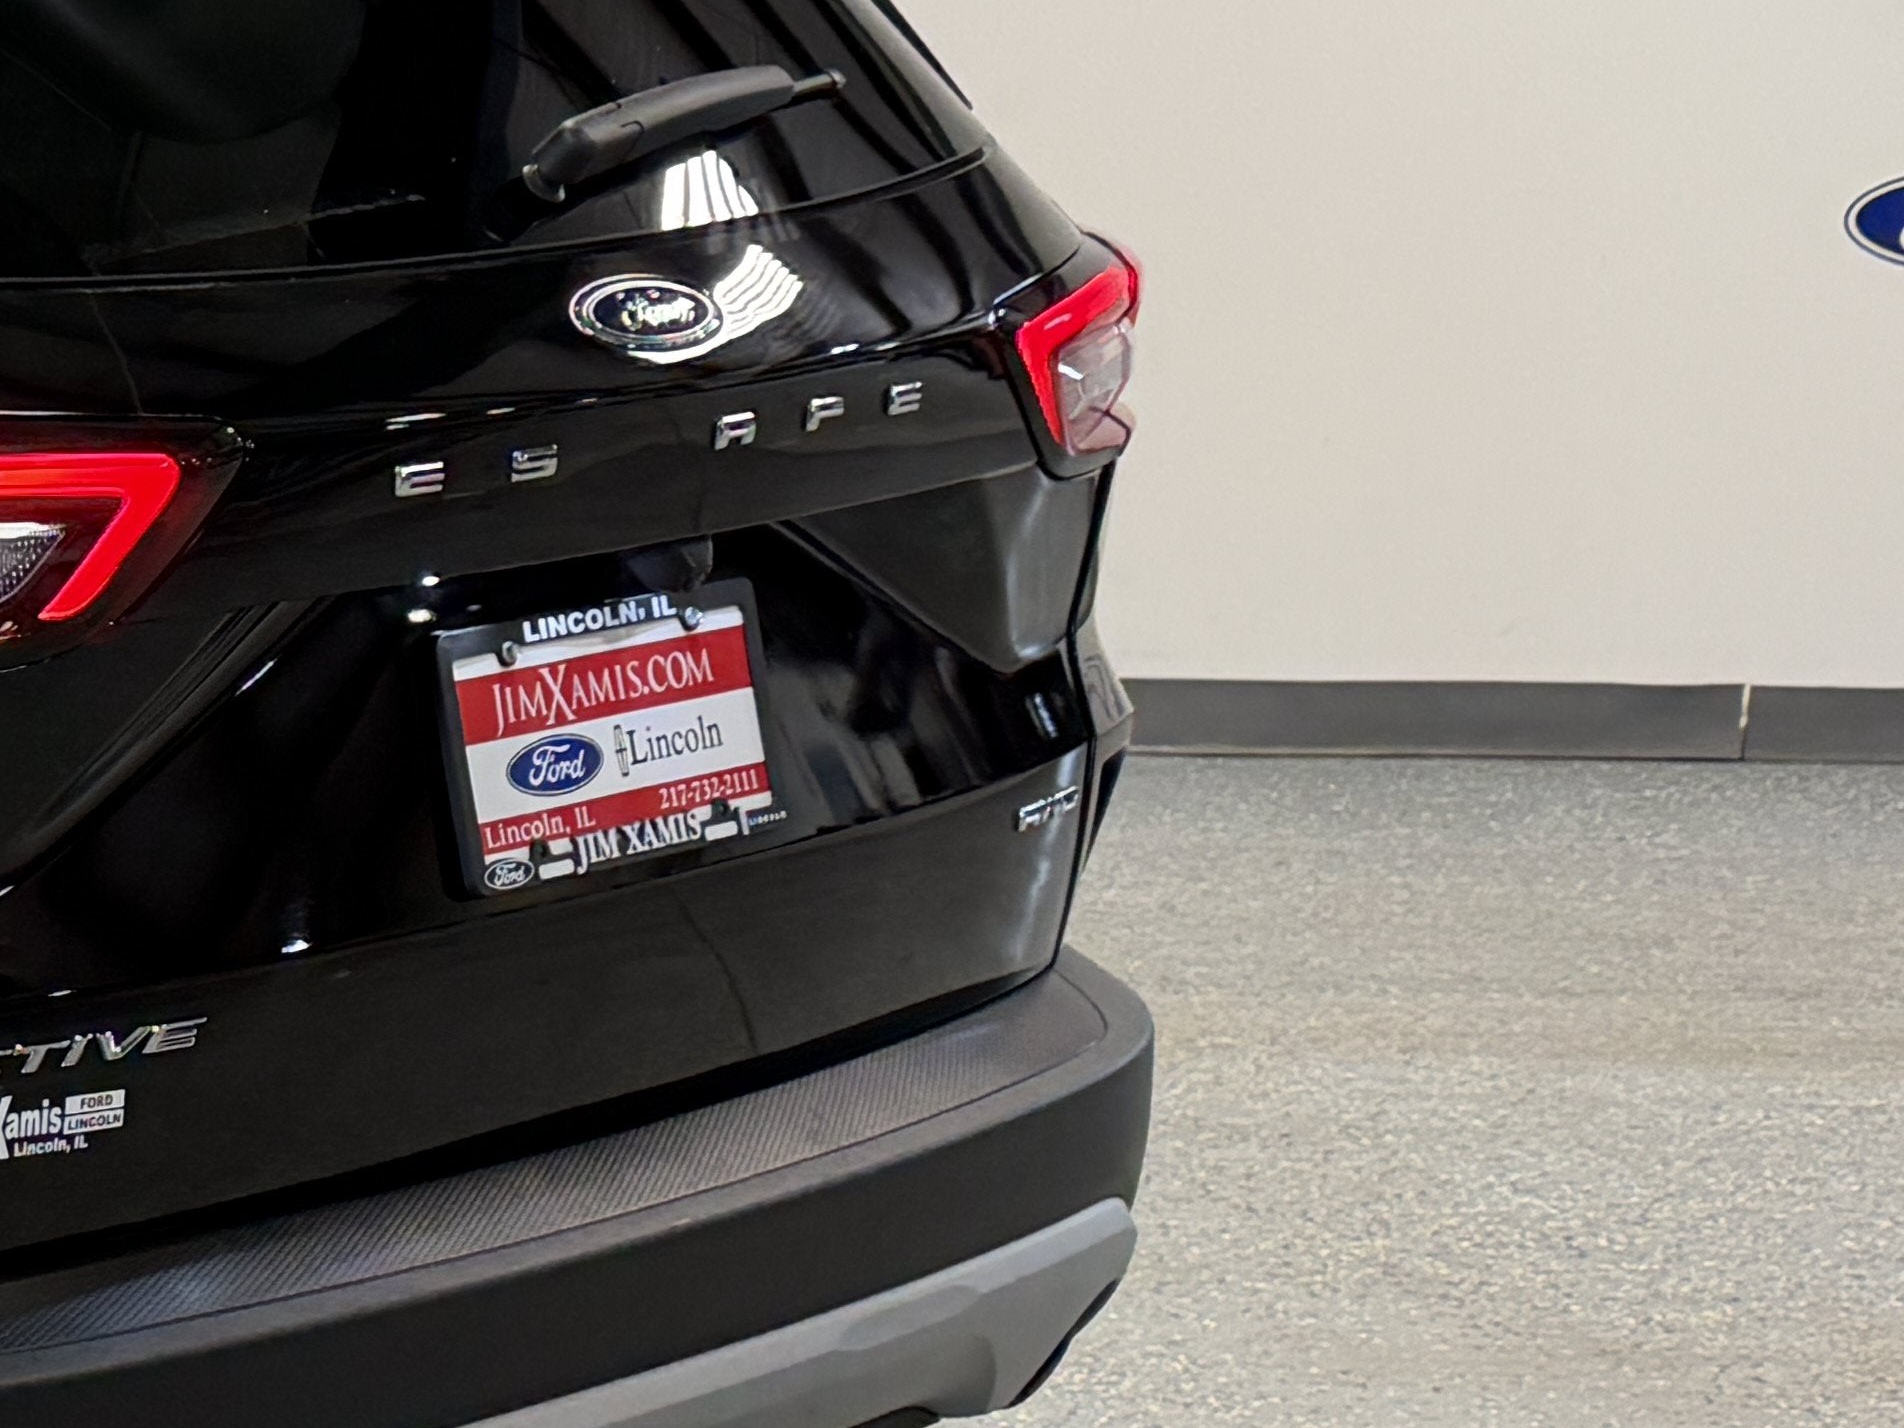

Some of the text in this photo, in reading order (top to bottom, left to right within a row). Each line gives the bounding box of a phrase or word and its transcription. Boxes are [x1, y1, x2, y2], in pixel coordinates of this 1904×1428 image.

[394, 381, 923, 498] ESAPE
[522, 594, 677, 643] LINCOLN, IL
[528, 715, 724, 785] Ford Lincoln
[658, 768, 759, 809] 217-732-2111
[484, 805, 597, 849] Lincoln, IL
[575, 811, 702, 875] JIM XAMIS
[494, 862, 526, 886] Ford
[67, 1113, 122, 1131] LINCOLN
[80, 1093, 114, 1110] FORD
[13, 1134, 89, 1157] Lincoln, IL
